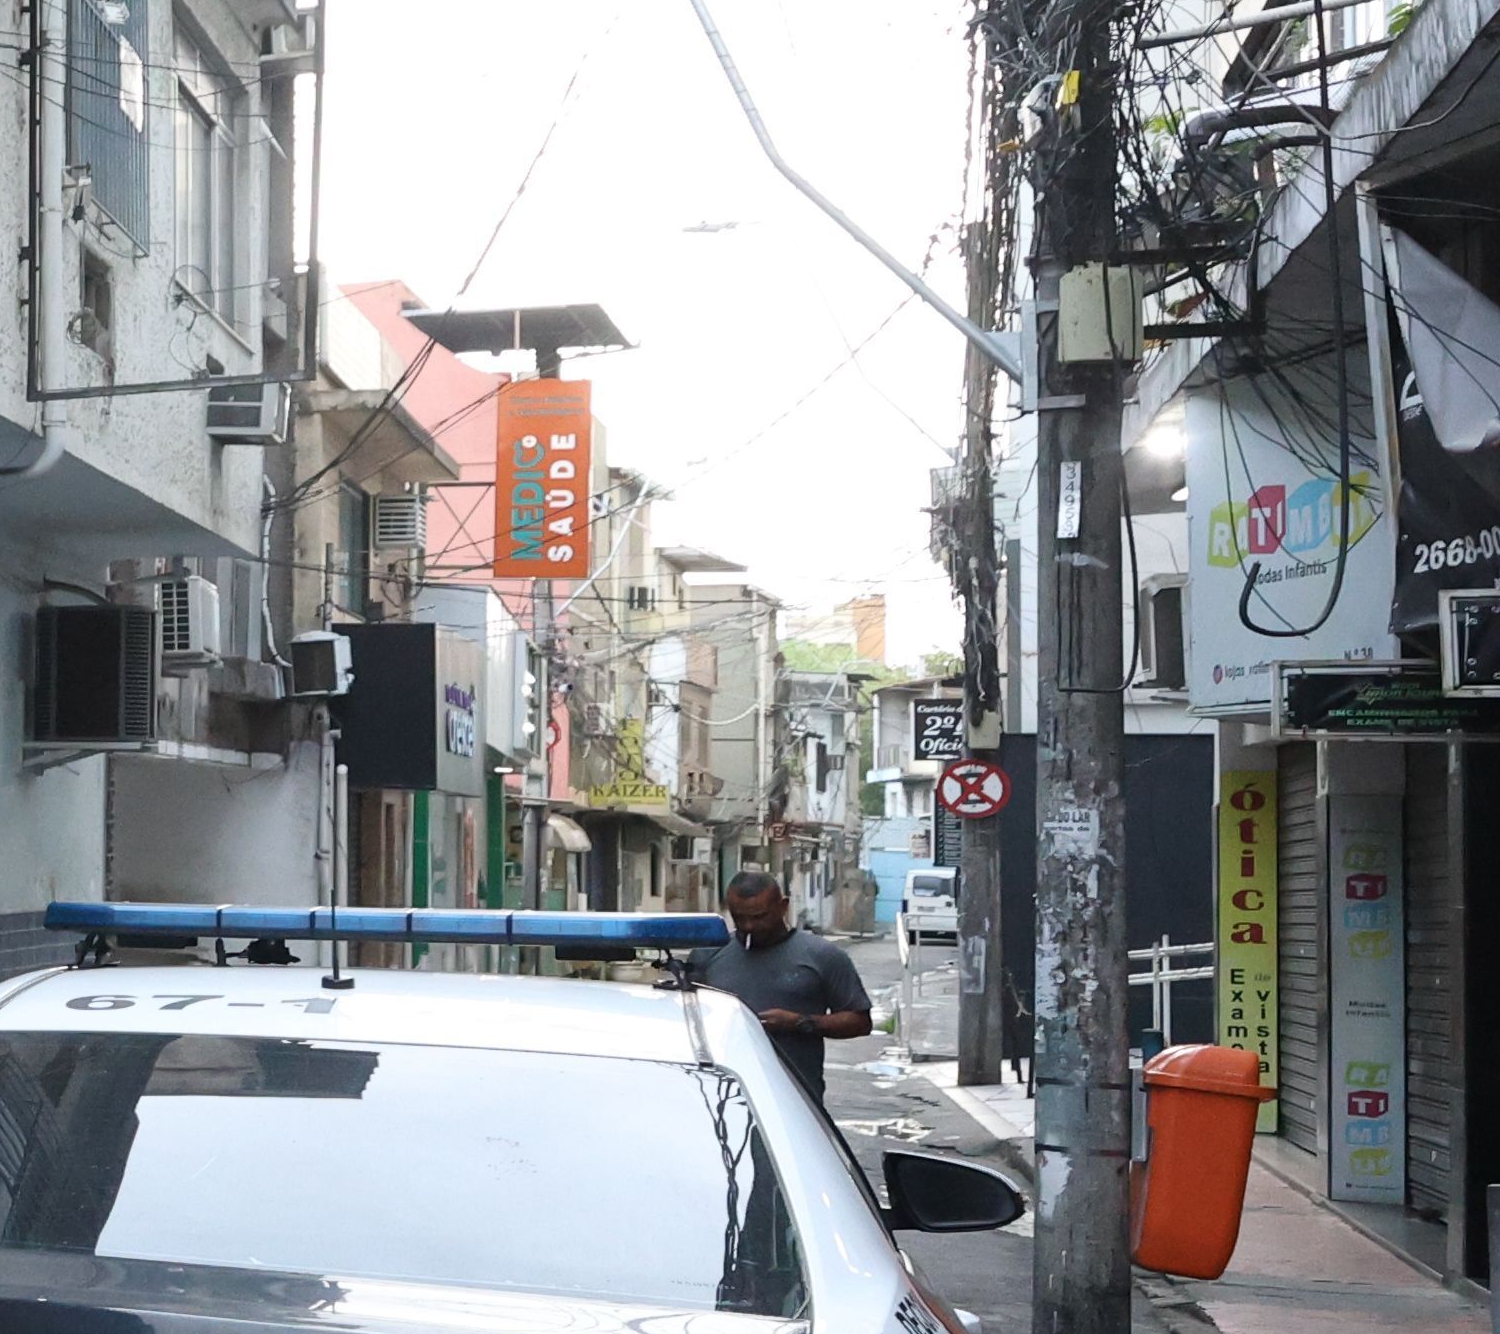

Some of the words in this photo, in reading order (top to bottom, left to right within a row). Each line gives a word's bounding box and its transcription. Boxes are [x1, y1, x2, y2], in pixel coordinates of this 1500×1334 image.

[545, 433, 577, 563] SAÚDE
[1253, 566, 1283, 586] odas
[591, 783, 667, 798] KAIZER
[1256, 989, 1270, 1073] vista
